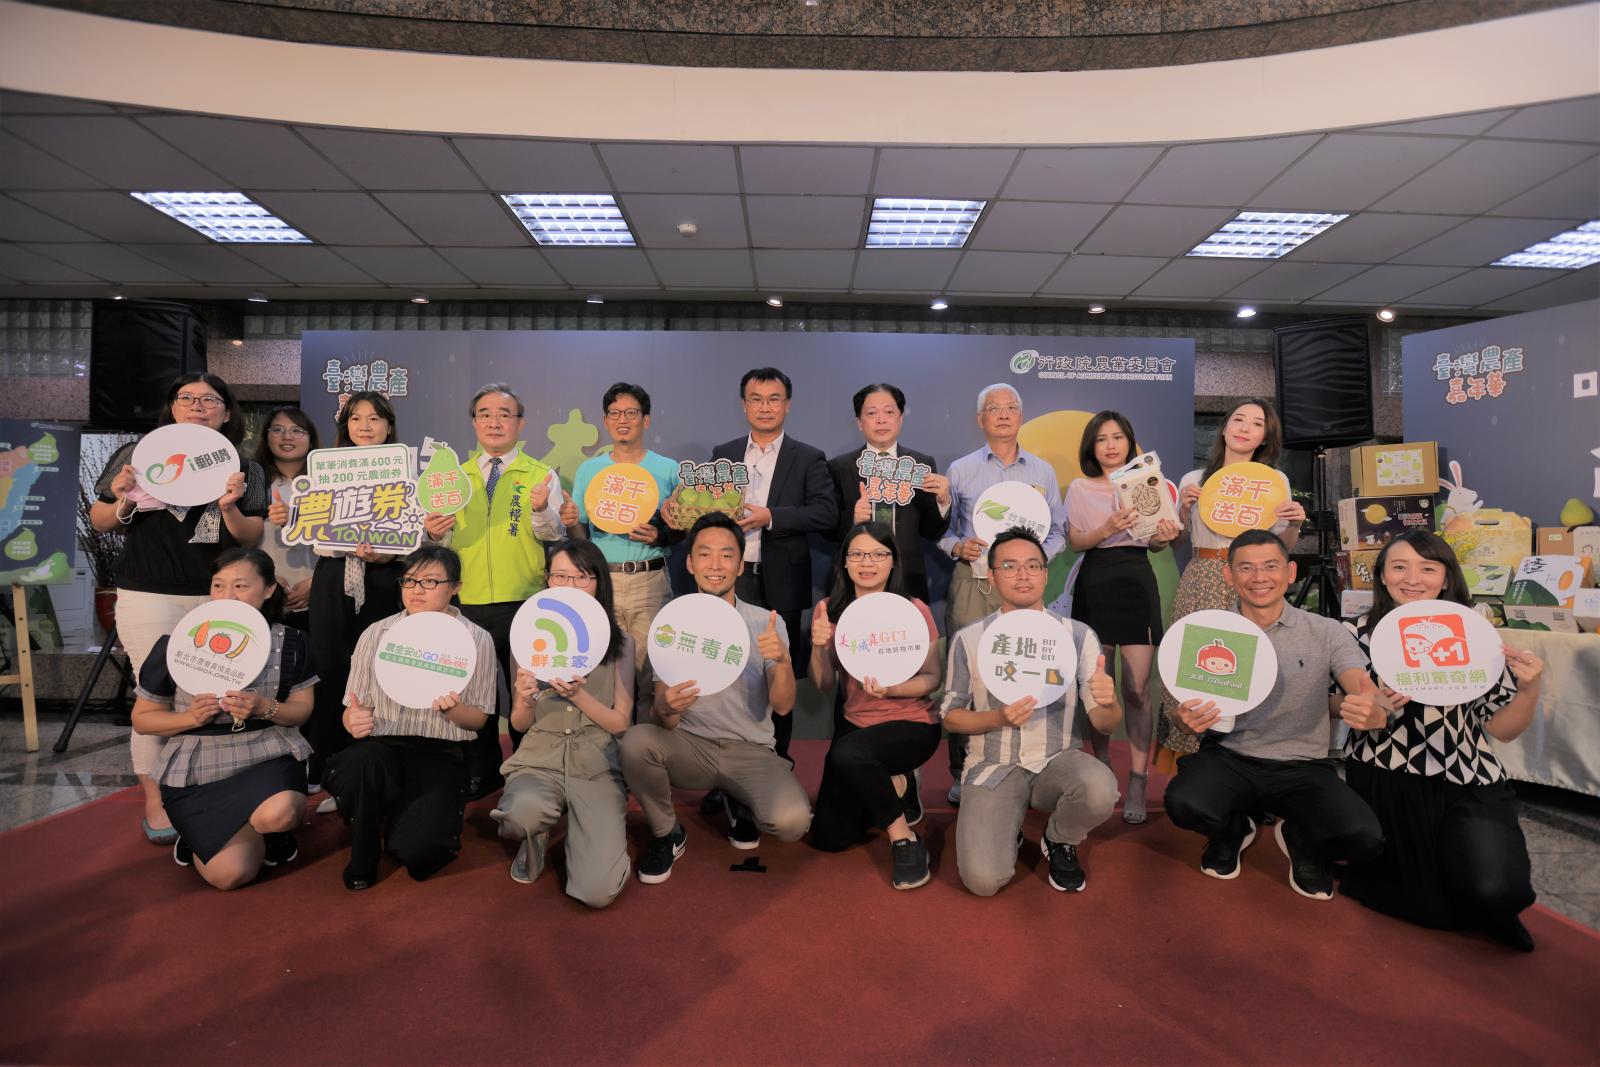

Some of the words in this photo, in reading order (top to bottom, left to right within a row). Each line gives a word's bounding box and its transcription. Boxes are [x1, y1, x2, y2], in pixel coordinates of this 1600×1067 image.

[1038, 355, 1176, 373] 行政院農業委員會
[1433, 345, 1523, 380] 臺灣農產
[322, 359, 408, 396] 臺灣農產
[1446, 371, 1506, 404] 嘉年華
[427, 471, 459, 489] 滿千
[679, 461, 749, 485] 臺灣農產
[858, 450, 930, 486] 臺灣農產
[431, 490, 462, 508] 送百
[604, 474, 647, 499] 滿千
[866, 476, 913, 504] 嘉年華
[1217, 473, 1272, 500] 滿千
[288, 482, 408, 541] 農遊券
[507, 494, 522, 537] 農糧署
[595, 500, 640, 524] 送百
[1210, 501, 1264, 527] 送百
[991, 633, 1037, 659] 產地
[531, 654, 588, 668] 鮮食家
[1396, 669, 1488, 685] 福利驚奇網
